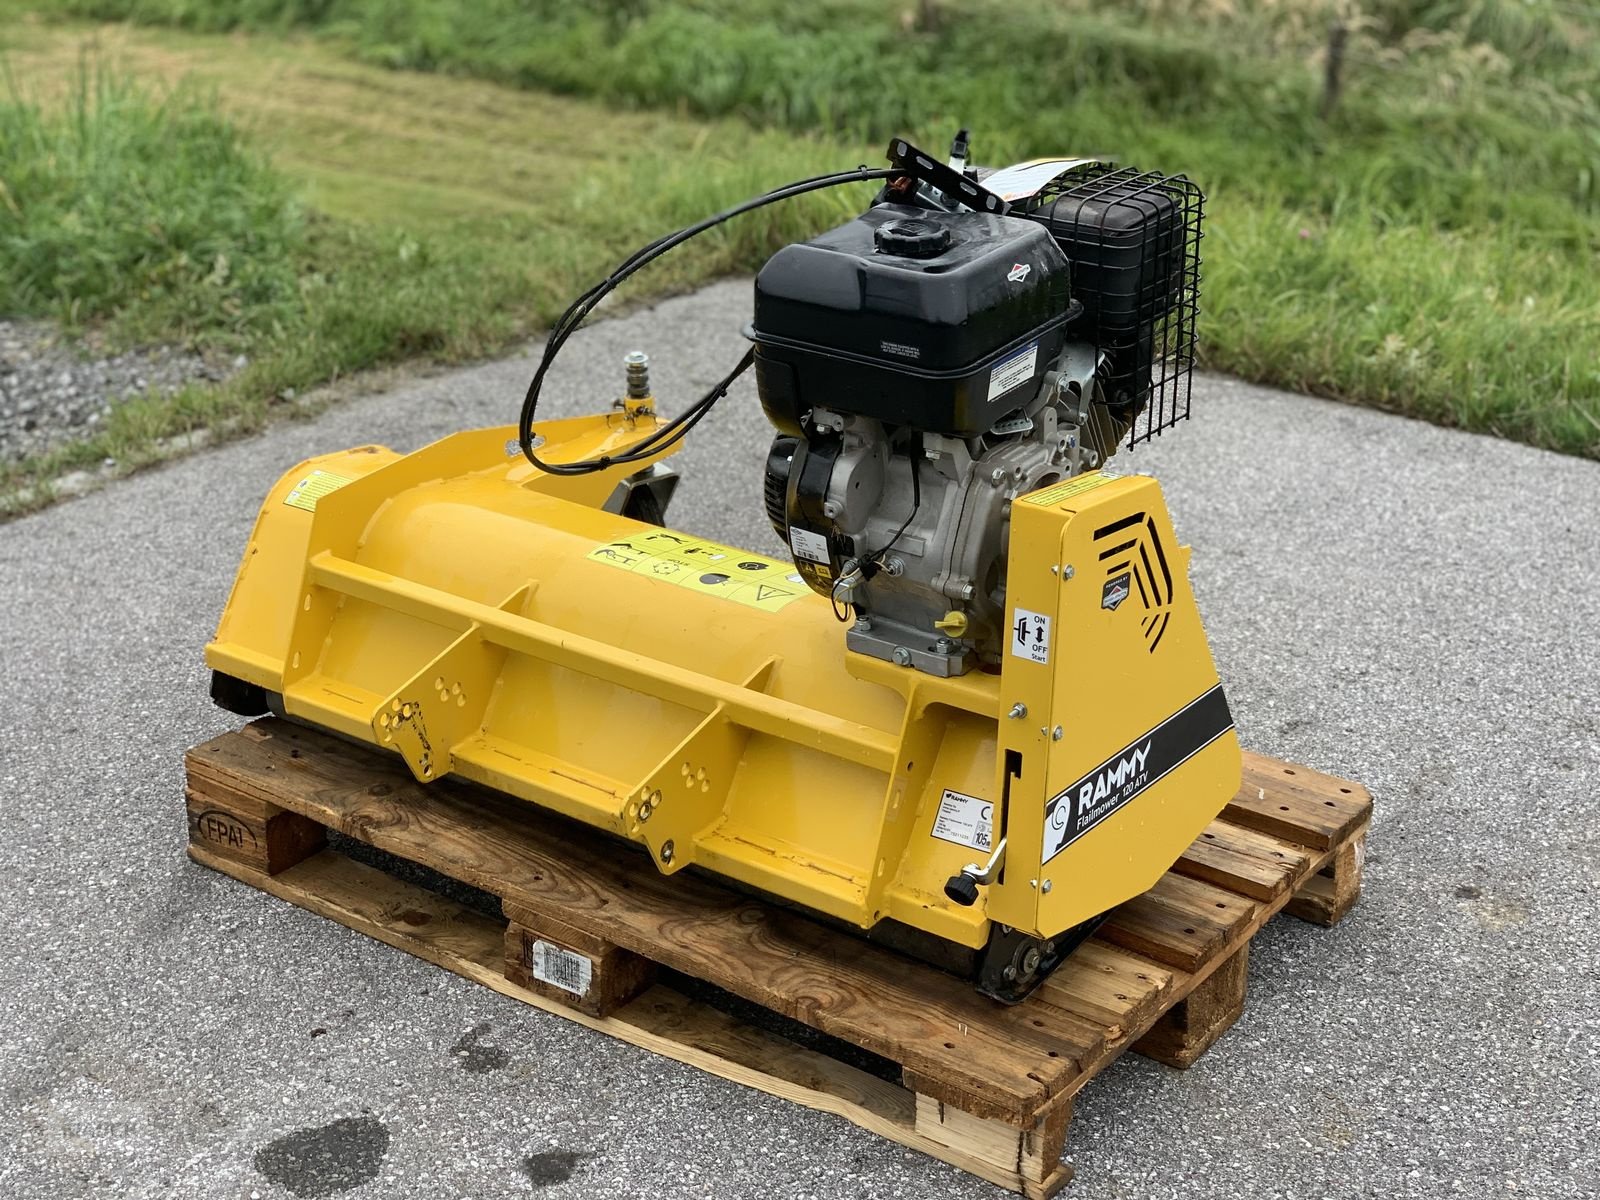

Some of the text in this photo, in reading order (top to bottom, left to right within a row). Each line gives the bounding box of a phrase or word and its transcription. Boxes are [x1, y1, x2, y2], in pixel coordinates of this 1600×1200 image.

[1034, 615, 1046, 625] ON
[1032, 644, 1048, 654] OFF
[1031, 653, 1046, 662] Start
[1078, 739, 1151, 816] RAMMY
[951, 795, 969, 804] RAMMY
[1076, 771, 1149, 831] Flailmower 120 ATV
[975, 832, 988, 846] 105
